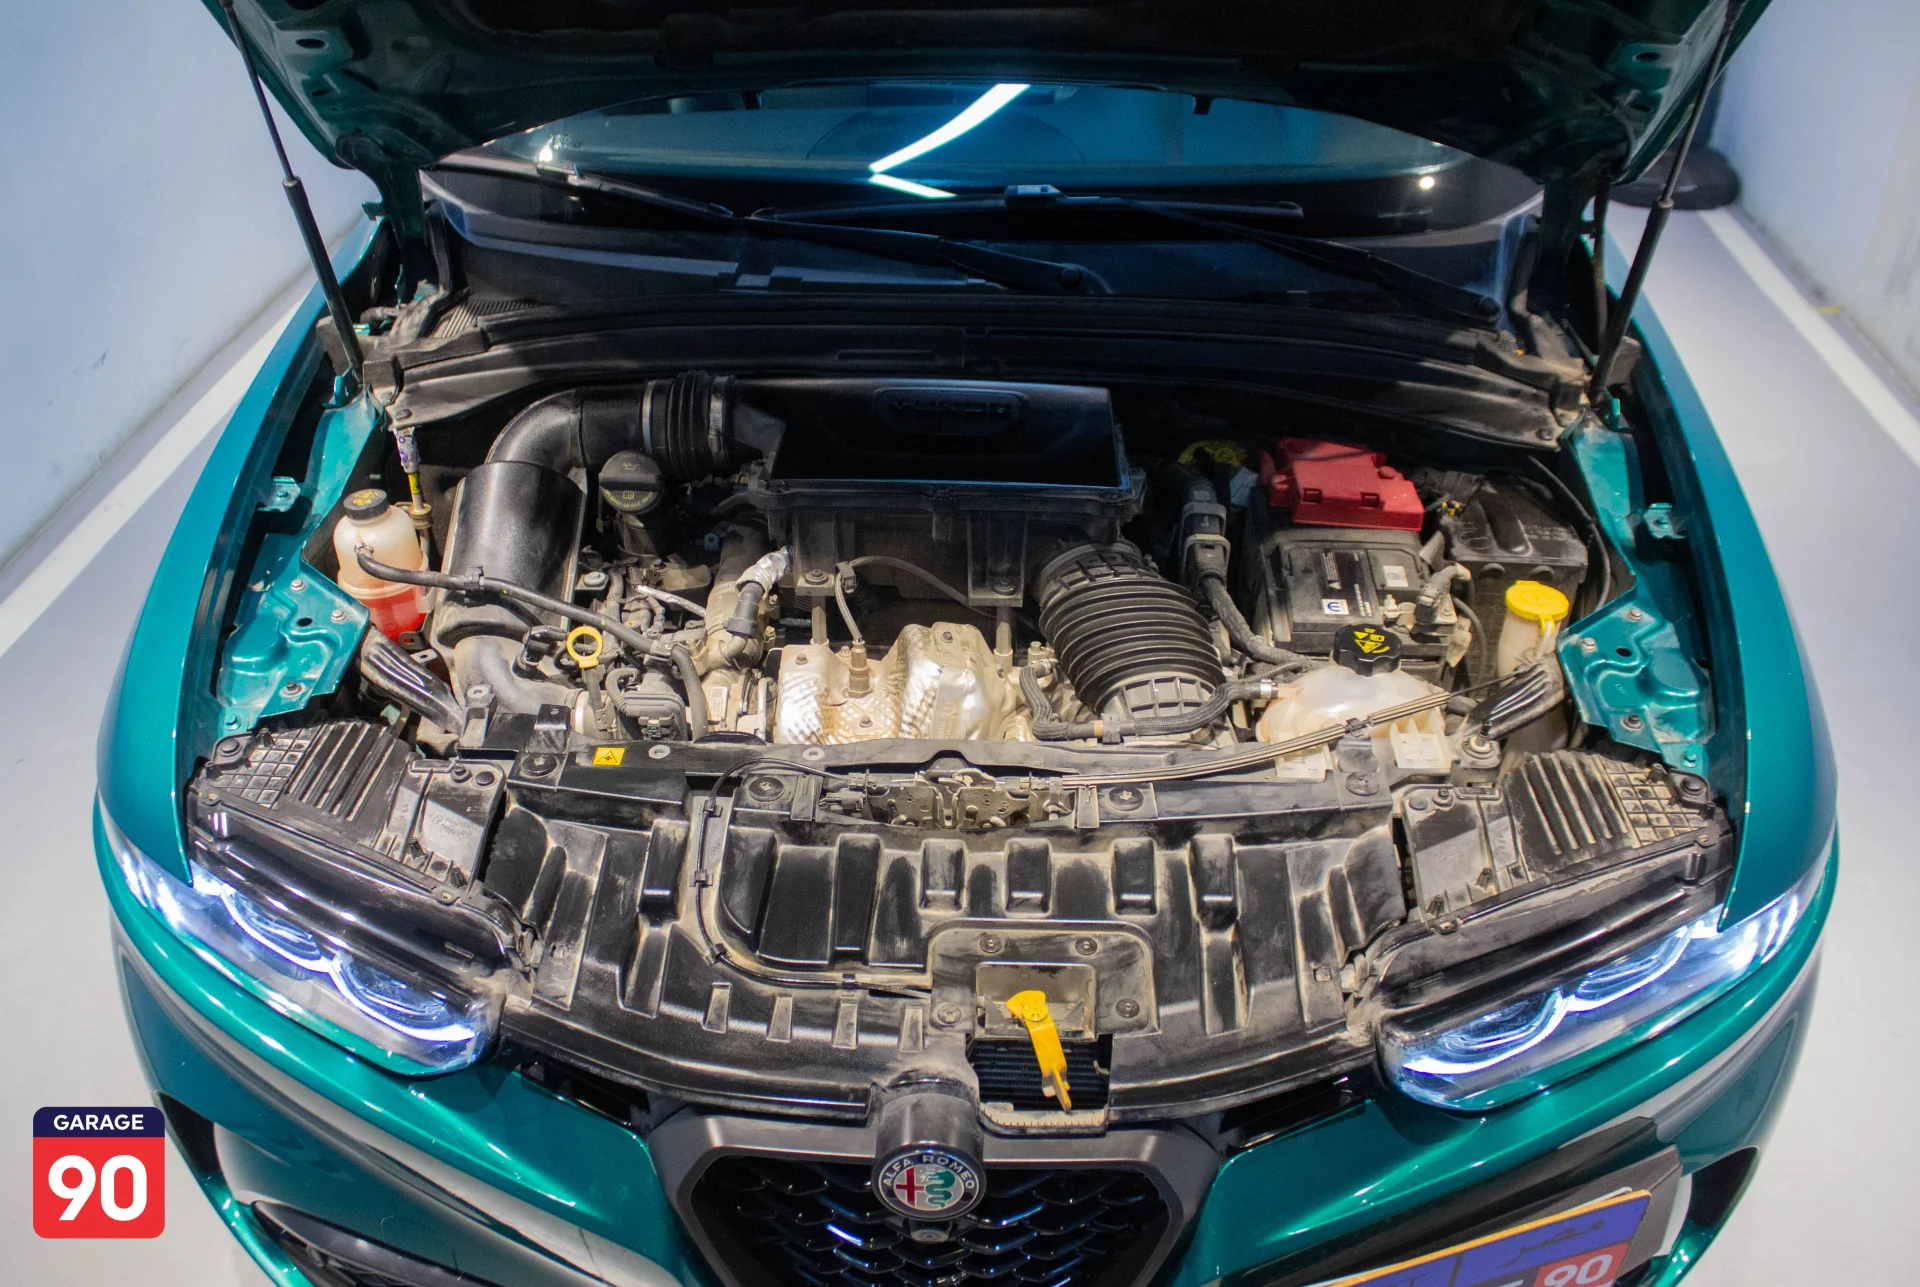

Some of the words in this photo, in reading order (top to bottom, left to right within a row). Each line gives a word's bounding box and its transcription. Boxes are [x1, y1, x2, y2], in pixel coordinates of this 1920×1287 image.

[883, 1158, 913, 1187] ALFA
[922, 1155, 976, 1189] ROMEO
[1543, 1254, 1613, 1287] 90
